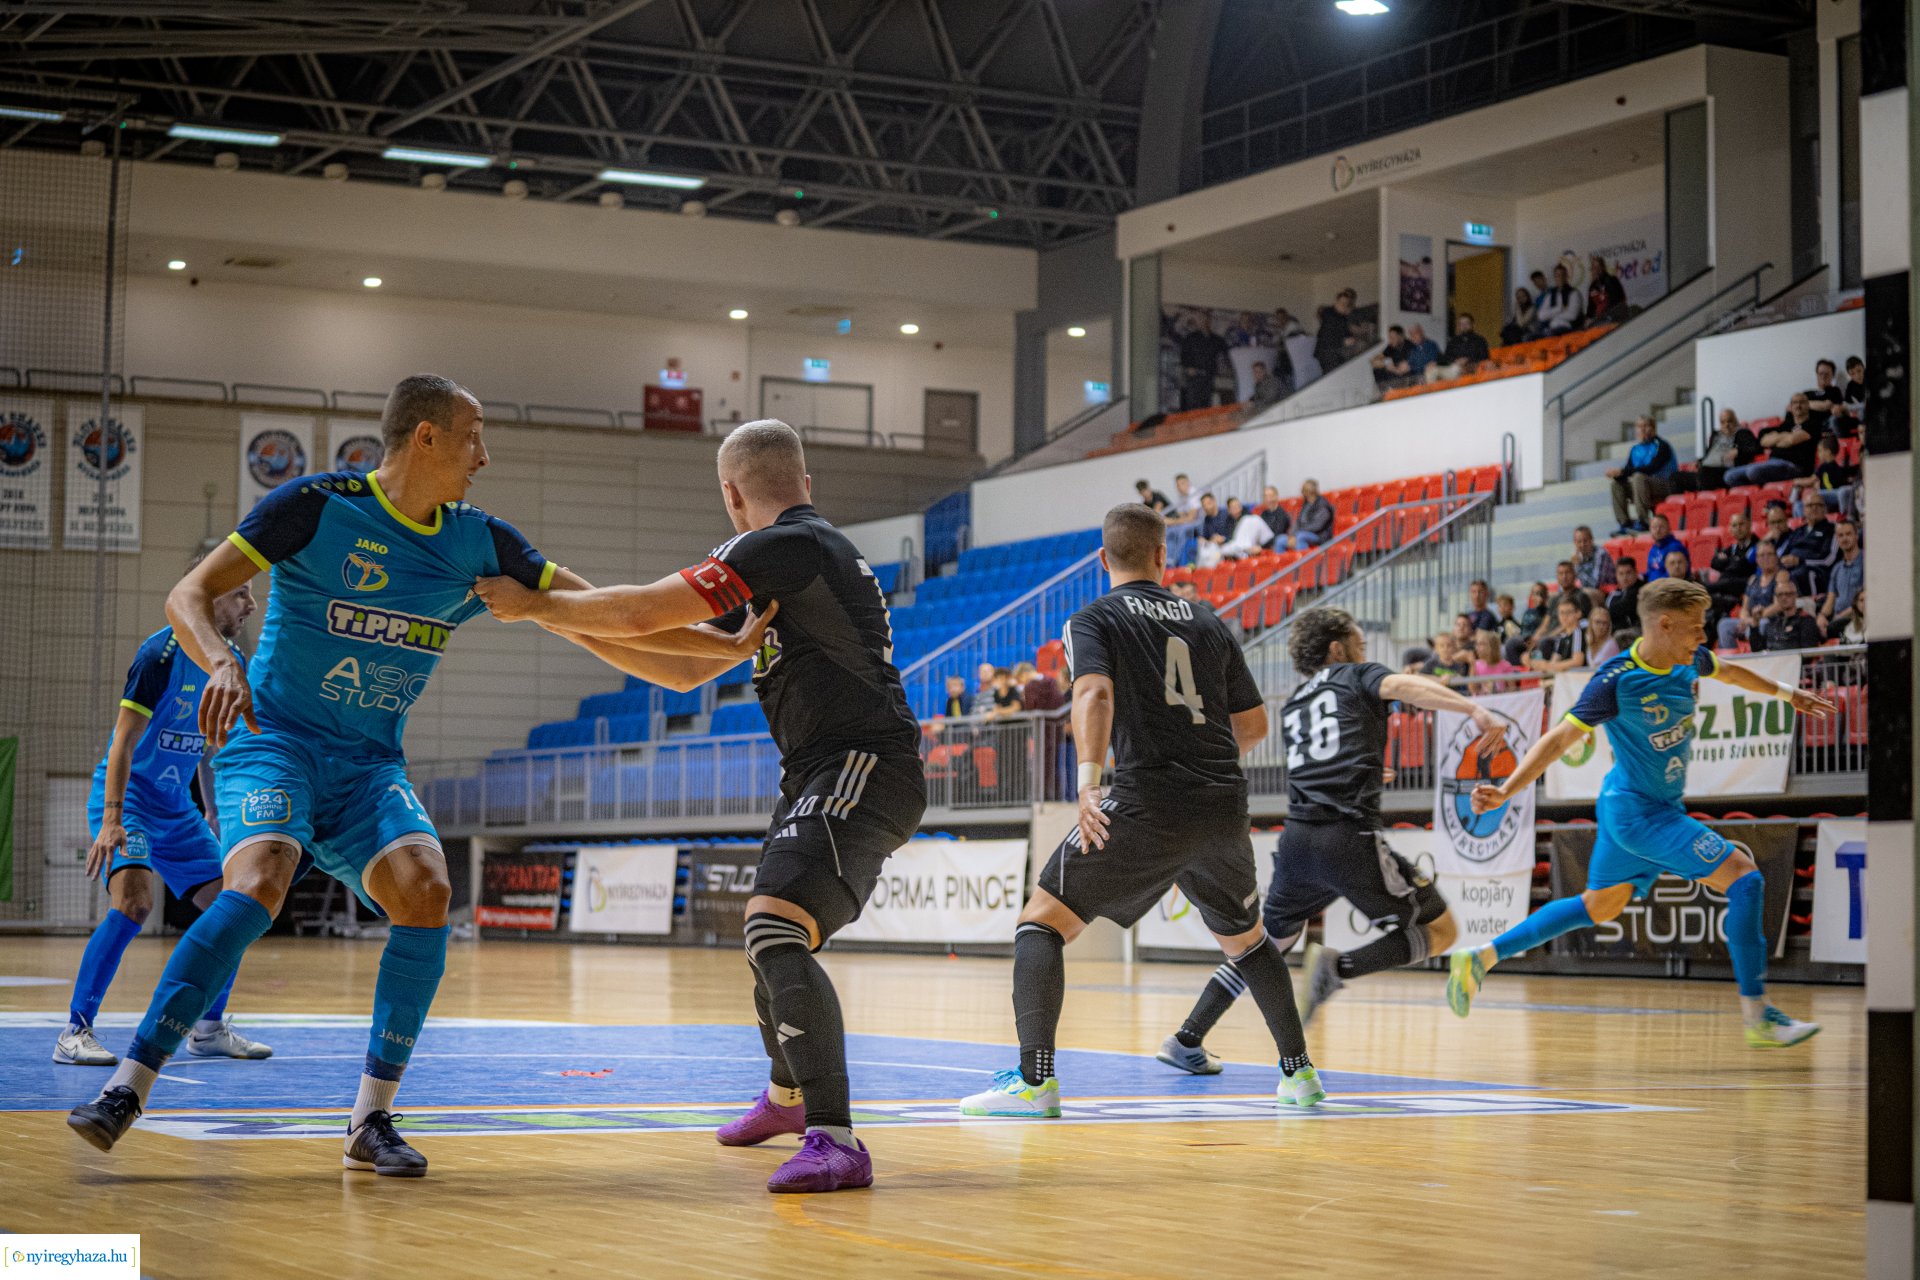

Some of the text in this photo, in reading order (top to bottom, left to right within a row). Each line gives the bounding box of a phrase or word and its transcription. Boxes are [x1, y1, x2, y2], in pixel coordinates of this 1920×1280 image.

[354, 538, 389, 555] JAKO
[693, 563, 728, 590] C
[1165, 636, 1206, 724] 4
[319, 681, 413, 716] STUDI
[249, 793, 284, 807] 99.4
[785, 795, 820, 819] 10
[256, 809, 275, 819] FM
[871, 874, 1018, 909] ORMA PINCE
[1466, 915, 1509, 935] water
[155, 1014, 192, 1038] JAKO
[378, 1028, 415, 1048] JAKO
